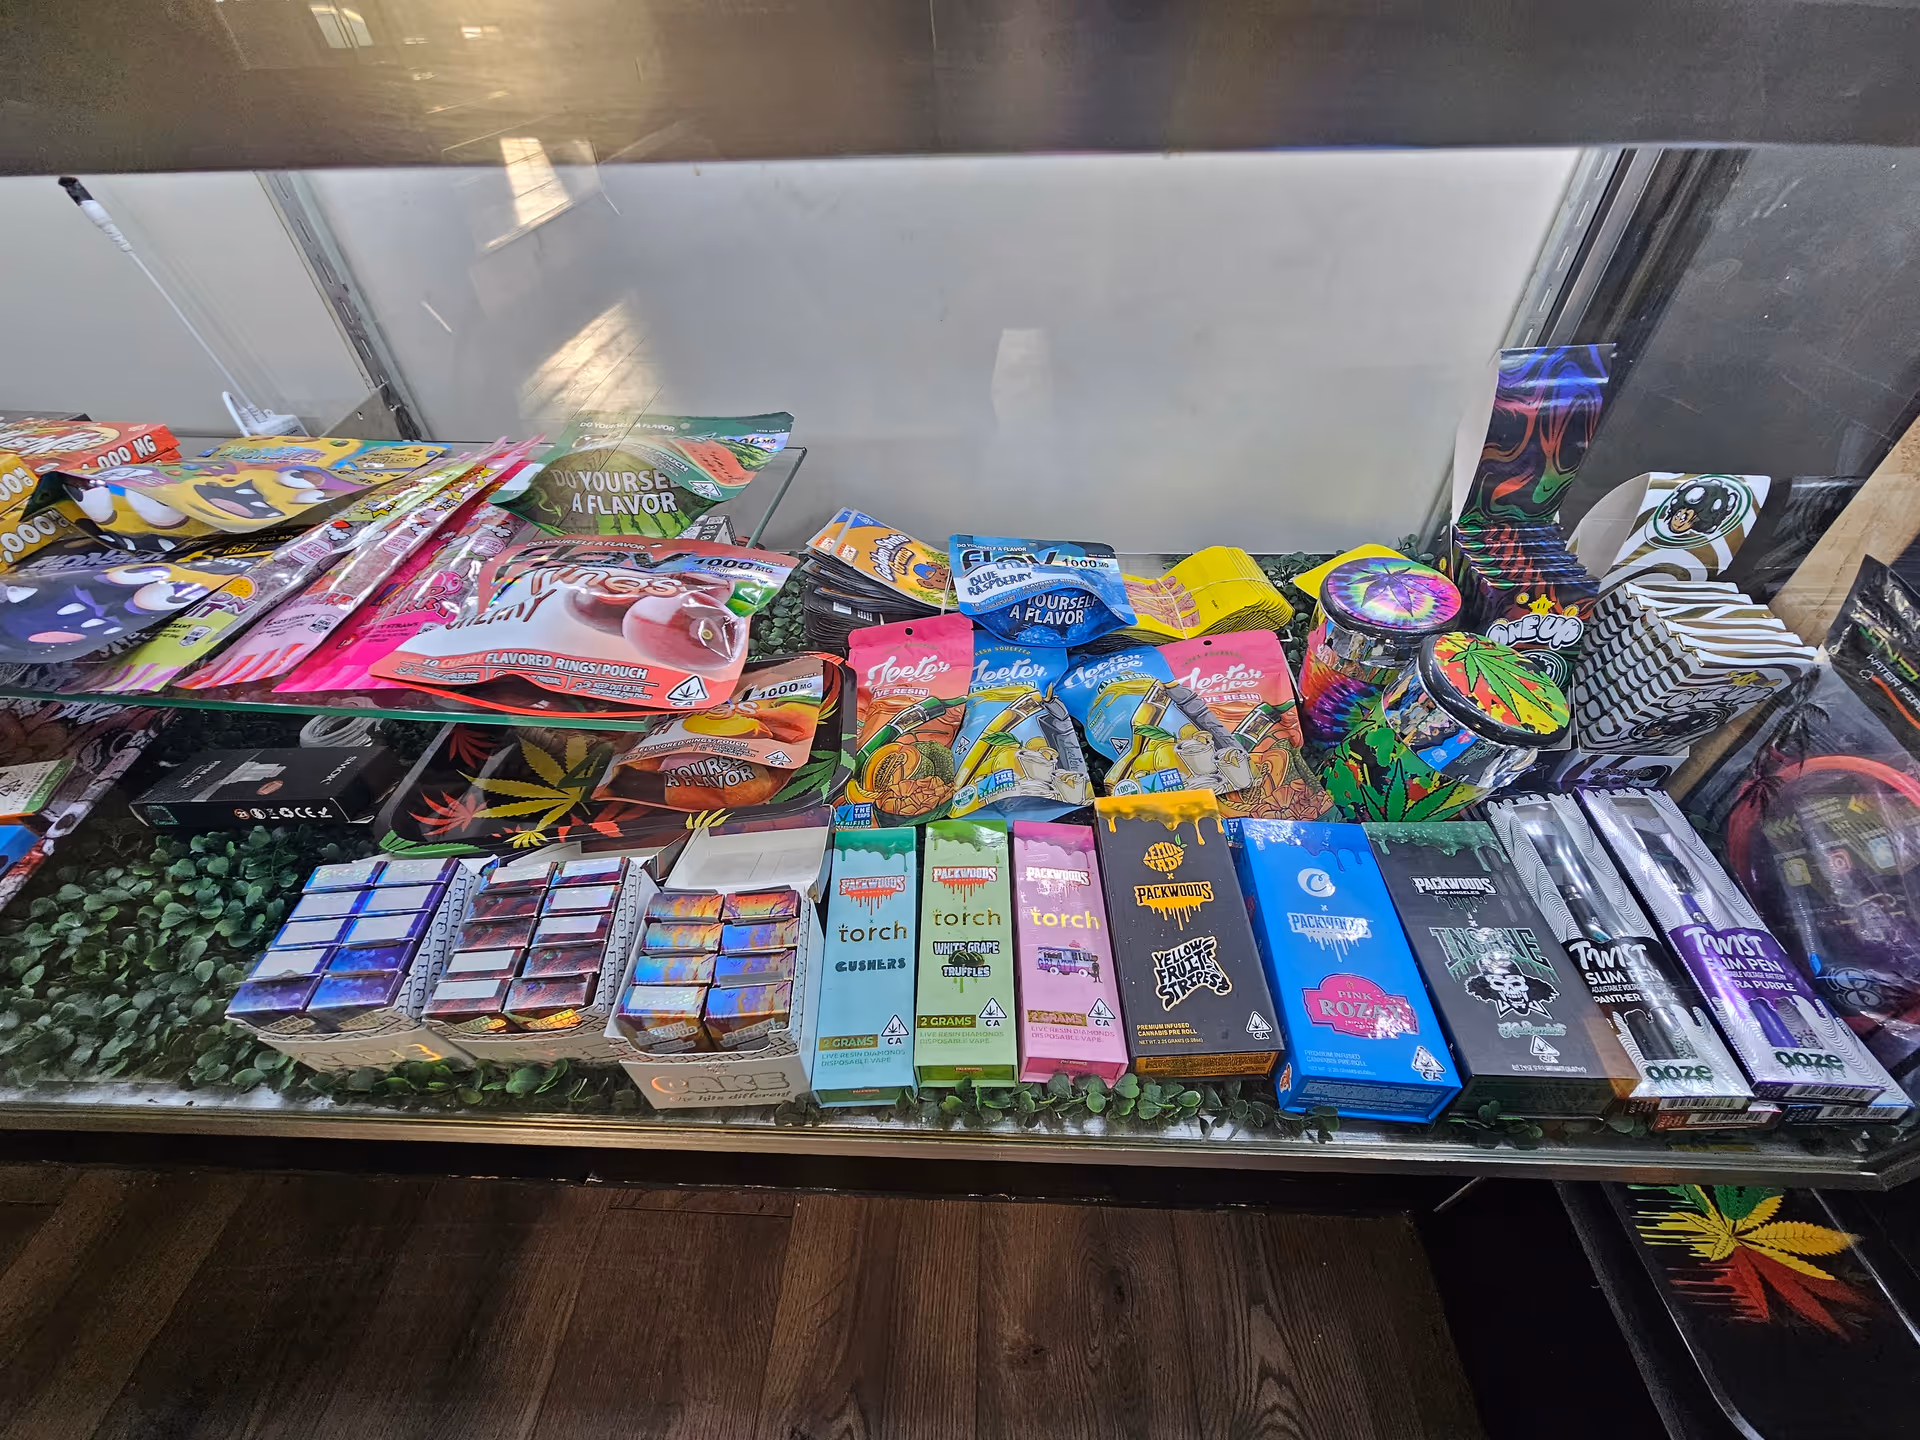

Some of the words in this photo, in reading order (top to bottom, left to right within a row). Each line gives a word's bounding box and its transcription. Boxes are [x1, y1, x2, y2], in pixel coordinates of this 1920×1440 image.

[642, 423, 676, 432] FLAVOR
[132, 434, 157, 459] MG
[551, 469, 578, 489] DO
[572, 493, 583, 514] A
[587, 492, 678, 516] FLAVOR
[543, 539, 595, 547] YOURSELF
[604, 541, 645, 551] FLAVOR
[693, 558, 754, 570] 1000
[1062, 557, 1097, 568] 1000
[967, 572, 1032, 596] RASPBERRY
[969, 570, 998, 587] BLUE
[1009, 604, 1020, 620] A
[1025, 607, 1084, 625] FLAVOR
[422, 659, 440, 667] 10
[484, 652, 552, 667] FLAVORED
[554, 657, 648, 680] RINGS/POUCH
[864, 655, 951, 687] Jeeter
[972, 658, 1047, 685] Jeeter
[1866, 653, 1902, 687] WATER
[759, 683, 799, 698] 1000
[892, 688, 927, 696] RESIN
[1223, 693, 1260, 701] RESIN
[639, 739, 686, 752] FLAVORED
[684, 765, 755, 788] FLAVOR
[995, 771, 1013, 780] THE
[1161, 773, 1180, 781] THE
[978, 782, 1014, 799] VERIFIED
[1116, 783, 1136, 794] 100%
[854, 806, 871, 814] THE
[932, 867, 997, 882] PACKWOODS
[1026, 866, 1091, 886] PACKWOODS
[840, 876, 905, 895] PACKWOODS
[1413, 876, 1497, 894] PACKWOODS
[1136, 883, 1212, 903] PACKWOODS
[932, 908, 1001, 926] torch
[1030, 907, 1100, 931] torch
[838, 920, 907, 943] torch
[933, 942, 965, 955] WHITE
[966, 941, 1000, 954] GRAPE
[1154, 938, 1203, 968] YELLOW
[835, 958, 907, 973] GUSHERS
[942, 966, 990, 977] TRUFFLES
[1156, 950, 1212, 985] FRUIT
[1745, 958, 1784, 973] PEN
[1585, 970, 1627, 985] SLIM
[1627, 969, 1665, 982] PEN
[1158, 970, 1220, 1009] STRIPES
[1591, 984, 1622, 993] ADJUSTABLE
[1752, 980, 1797, 992] PURPLE
[1337, 990, 1374, 1001] PINK
[1593, 993, 1642, 1004] PANTHER
[921, 1017, 927, 1026] 2
[930, 1016, 971, 1026] GRAMS
[985, 1019, 1001, 1027] CA
[1031, 1011, 1038, 1021] 2
[1041, 1013, 1083, 1024] GRAMS
[1095, 1019, 1110, 1027] CA
[1031, 1033, 1080, 1041] DISPOSABLE
[1073, 1029, 1115, 1037] DIAMONDS
[1138, 1029, 1168, 1037] CANNABIS
[832, 1036, 874, 1048] GRAMS
[887, 1037, 903, 1045] CA
[821, 1052, 839, 1060] LIVE
[840, 1051, 862, 1059] RESIN
[863, 1049, 906, 1057] DIAMONDS
[1775, 1049, 1843, 1069] ooze
[821, 1058, 869, 1067] DISPOSABLE
[1646, 1063, 1714, 1083] ooze
[727, 1090, 791, 1101] different
